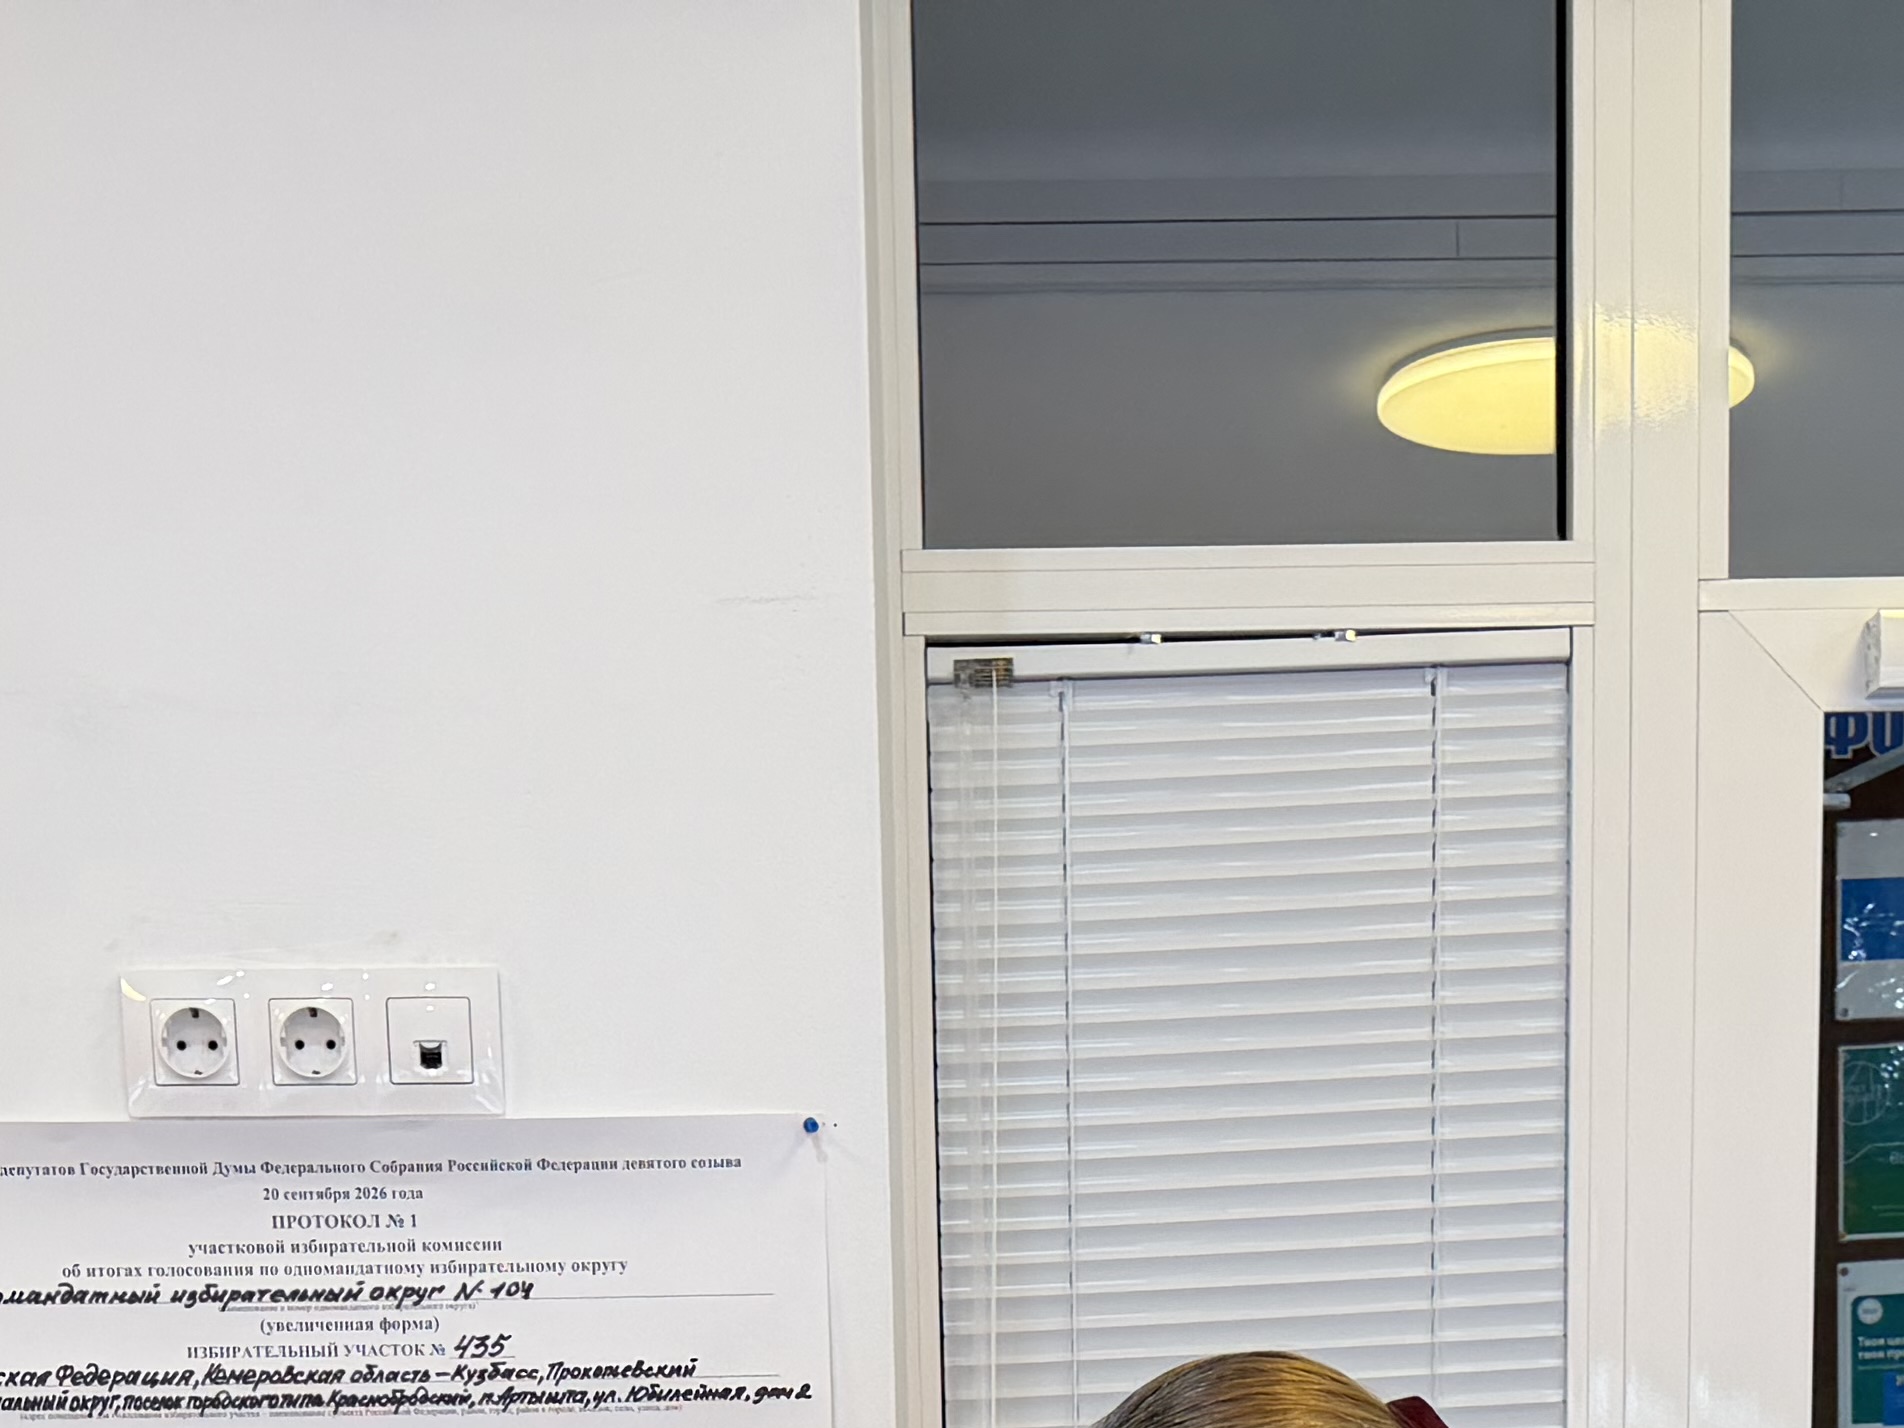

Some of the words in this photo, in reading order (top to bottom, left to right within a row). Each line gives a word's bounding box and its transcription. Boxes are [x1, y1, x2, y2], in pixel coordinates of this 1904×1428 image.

[0, 1166, 74, 1178] депутатов
[80, 1162, 207, 1178] Государственной
[213, 1161, 255, 1177] Думы
[260, 1162, 364, 1176] Федерального
[370, 1160, 441, 1175] Собрания
[448, 1159, 531, 1172] Российской
[537, 1159, 617, 1172] Федерации
[622, 1159, 685, 1170] девятого
[691, 1158, 740, 1168] созыва
[263, 1187, 278, 1201] 20
[284, 1187, 349, 1202] сентября
[355, 1186, 386, 1200] 2026
[392, 1189, 422, 1200] года
[272, 1214, 379, 1229] ПРОТОКОЛ
[385, 1213, 403, 1228] №
[411, 1213, 415, 1228] 1
[189, 1240, 284, 1257] участковой
[291, 1239, 415, 1255] избирательной
[422, 1240, 500, 1252] комиссии
[62, 1263, 80, 1278] об
[87, 1266, 141, 1277] итогах
[148, 1265, 252, 1277] голосования
[260, 1265, 277, 1276] по
[284, 1264, 423, 1277] одномандатному
[430, 1260, 565, 1276] избирательному
[571, 1261, 626, 1275] округу
[170, 1281, 363, 1312] избирательный
[369, 1284, 445, 1308] округ
[491, 1281, 534, 1300] 104
[260, 1320, 373, 1335] (увеличенная
[380, 1317, 438, 1334] форма)
[187, 1343, 337, 1358] ИЗБИРАТЕЛЬНЫЙ
[344, 1343, 424, 1357] УЧАСТОК
[429, 1343, 444, 1356] №
[454, 1334, 512, 1358] 435
[350, 1364, 431, 1383] область
